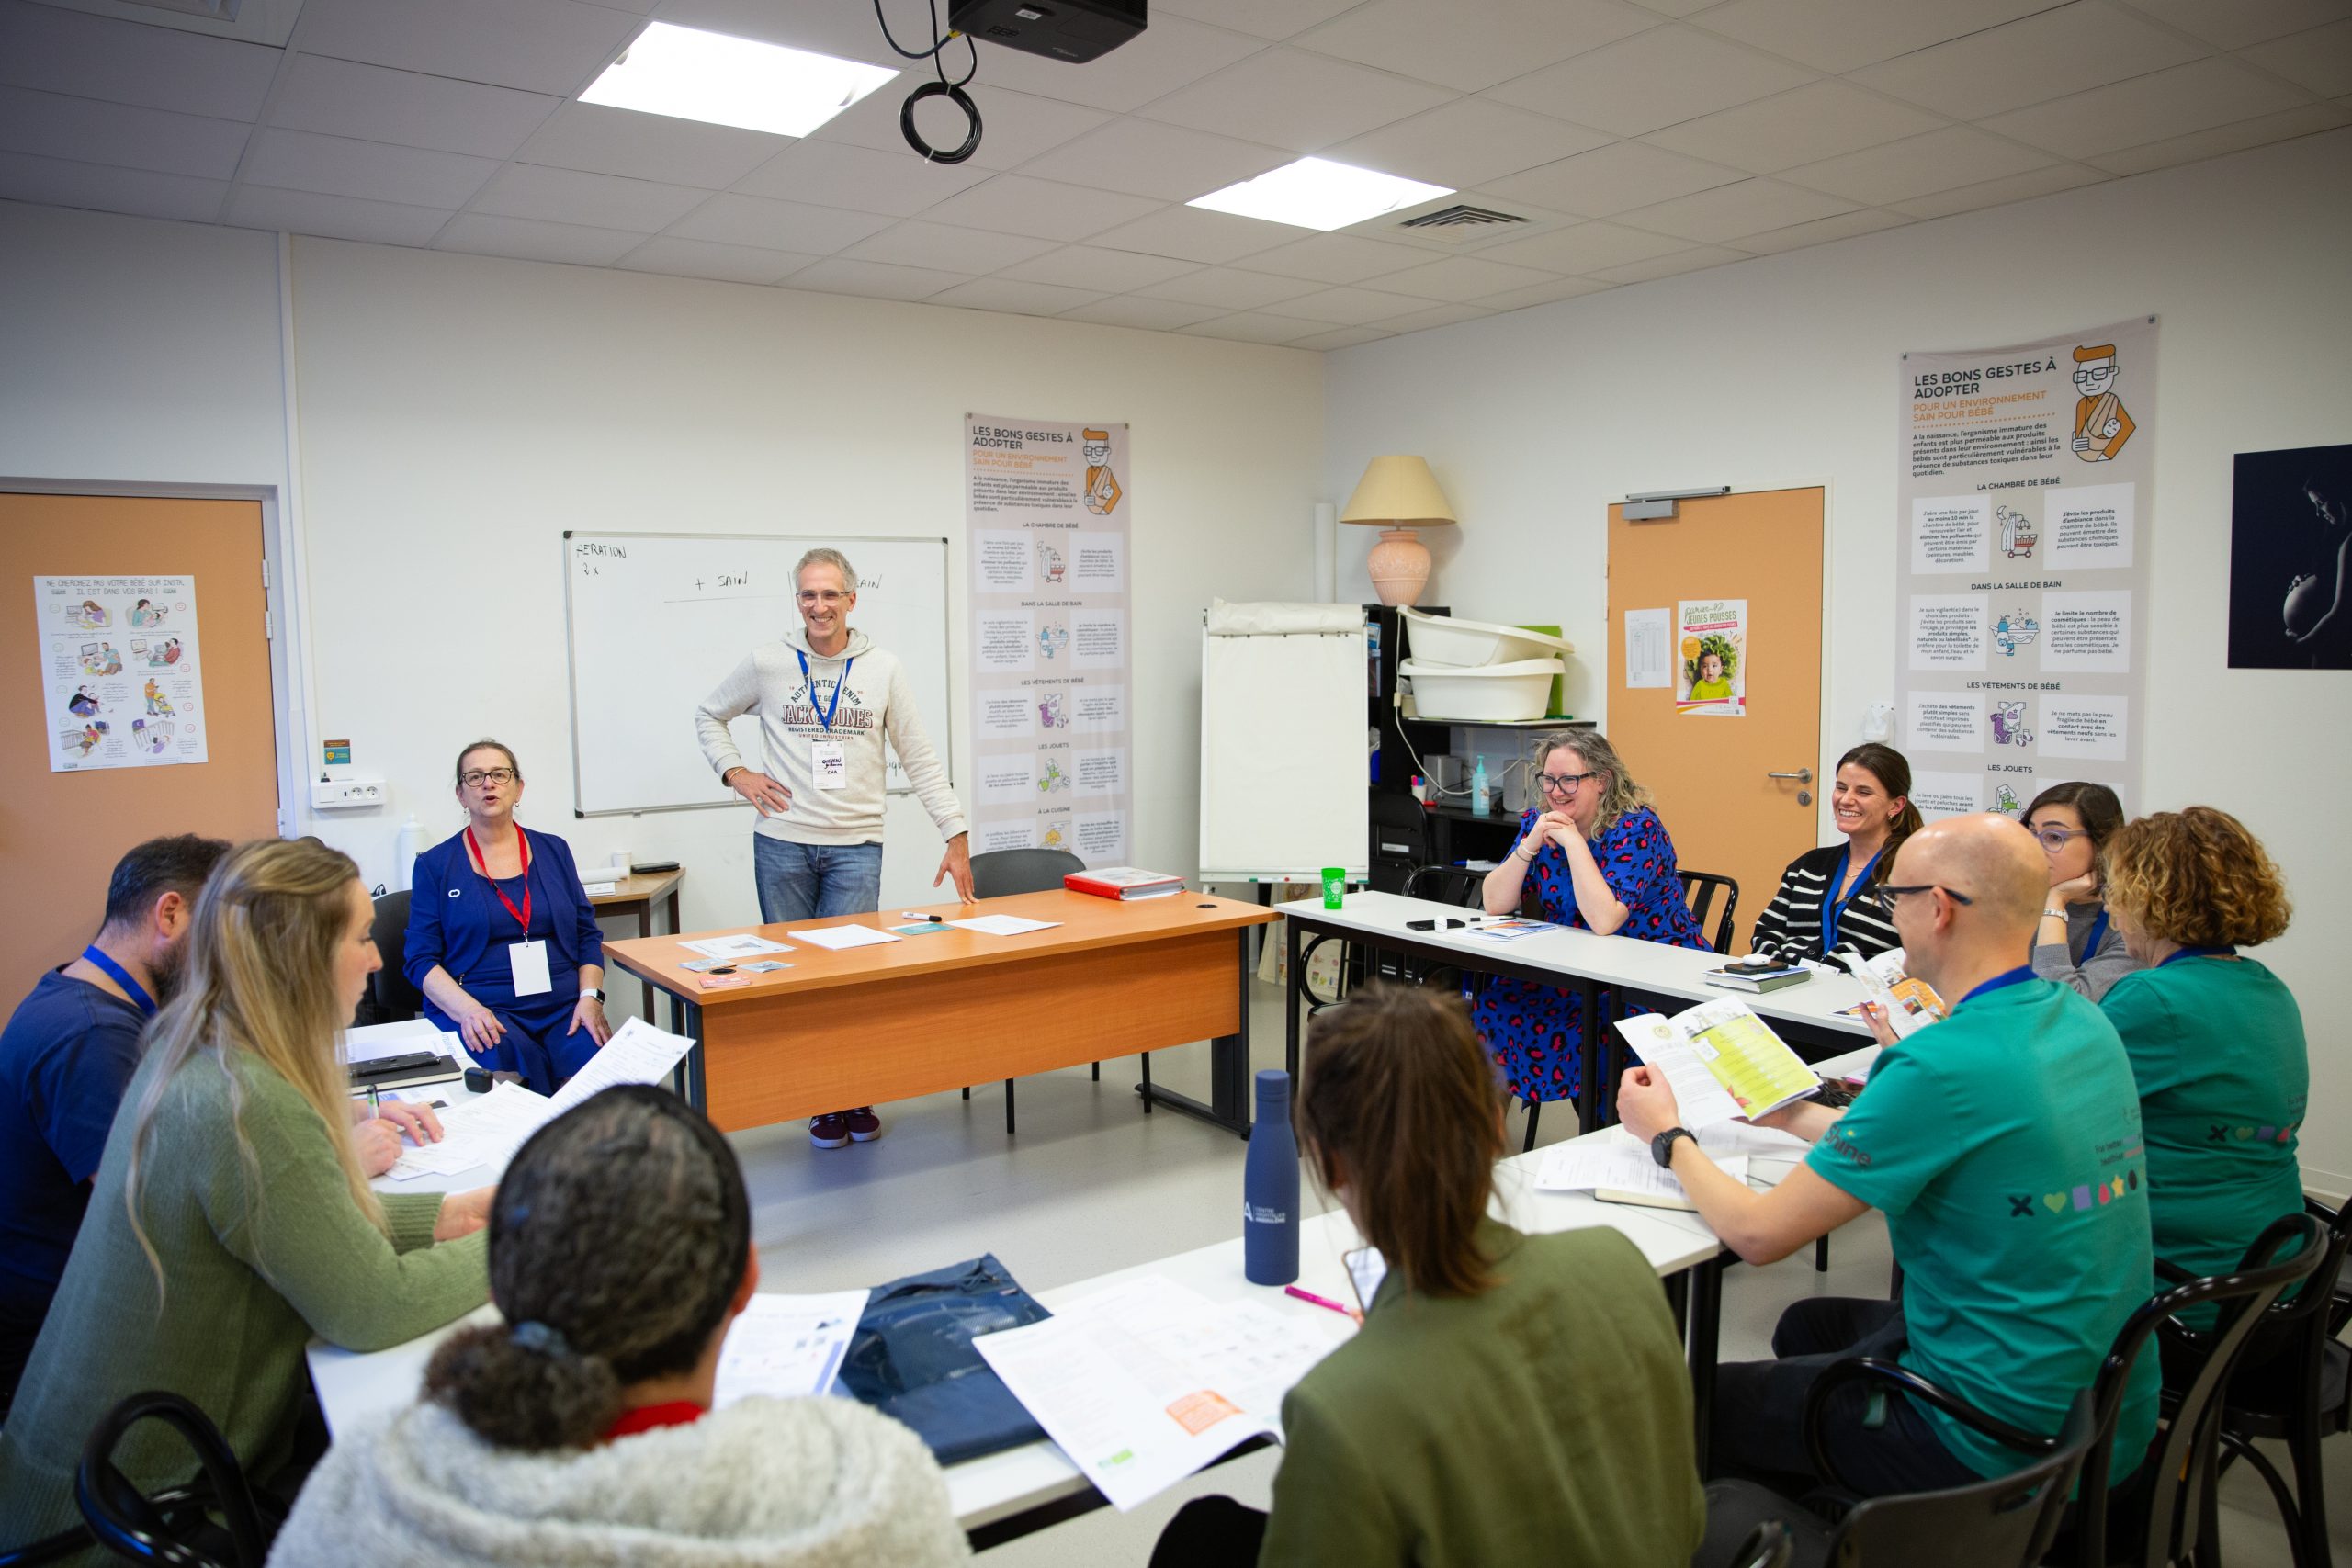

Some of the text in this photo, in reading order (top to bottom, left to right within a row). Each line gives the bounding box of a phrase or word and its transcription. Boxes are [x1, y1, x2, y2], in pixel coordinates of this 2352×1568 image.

[1915, 356, 2057, 386] LES BONS GESTES À
[1914, 383, 1980, 399] ADOPTER
[1913, 401, 1940, 411] POUR
[1960, 391, 2047, 407] ENVIRONNEMENT
[1913, 405, 1994, 421] SAIN POUR BÉBÉ
[973, 426, 1073, 443] LES BONS GESTES À
[1927, 431, 1959, 440] naissance,
[1999, 424, 2033, 433] immature
[1950, 437, 1963, 446] plus
[1965, 434, 2000, 445] perméable
[2016, 431, 2045, 440] produits
[973, 437, 1023, 449] ADOPTER
[1913, 446, 1939, 456] présents
[1973, 440, 2025, 449] environnement
[1007, 452, 1068, 462] ENVIRONNEMENT
[1949, 449, 2005, 460] particulièrement
[2007, 446, 2046, 454] vulnérables
[1014, 460, 1033, 468] BÉBÉ
[1913, 461, 1940, 470] présence
[1952, 457, 1988, 466] substances
[1990, 456, 2018, 465] toxiques
[1913, 468, 1944, 477] quotidien.
[130, 578, 145, 586] BÉBÉ
[718, 571, 748, 587] SAIN
[1687, 611, 1736, 625] JEUNES POUSSES
[1982, 681, 2025, 689] VÊTEMENTS
[842, 686, 862, 706] ENIM
[782, 705, 814, 725] JACK
[1825, 1124, 1871, 1165] Shine
